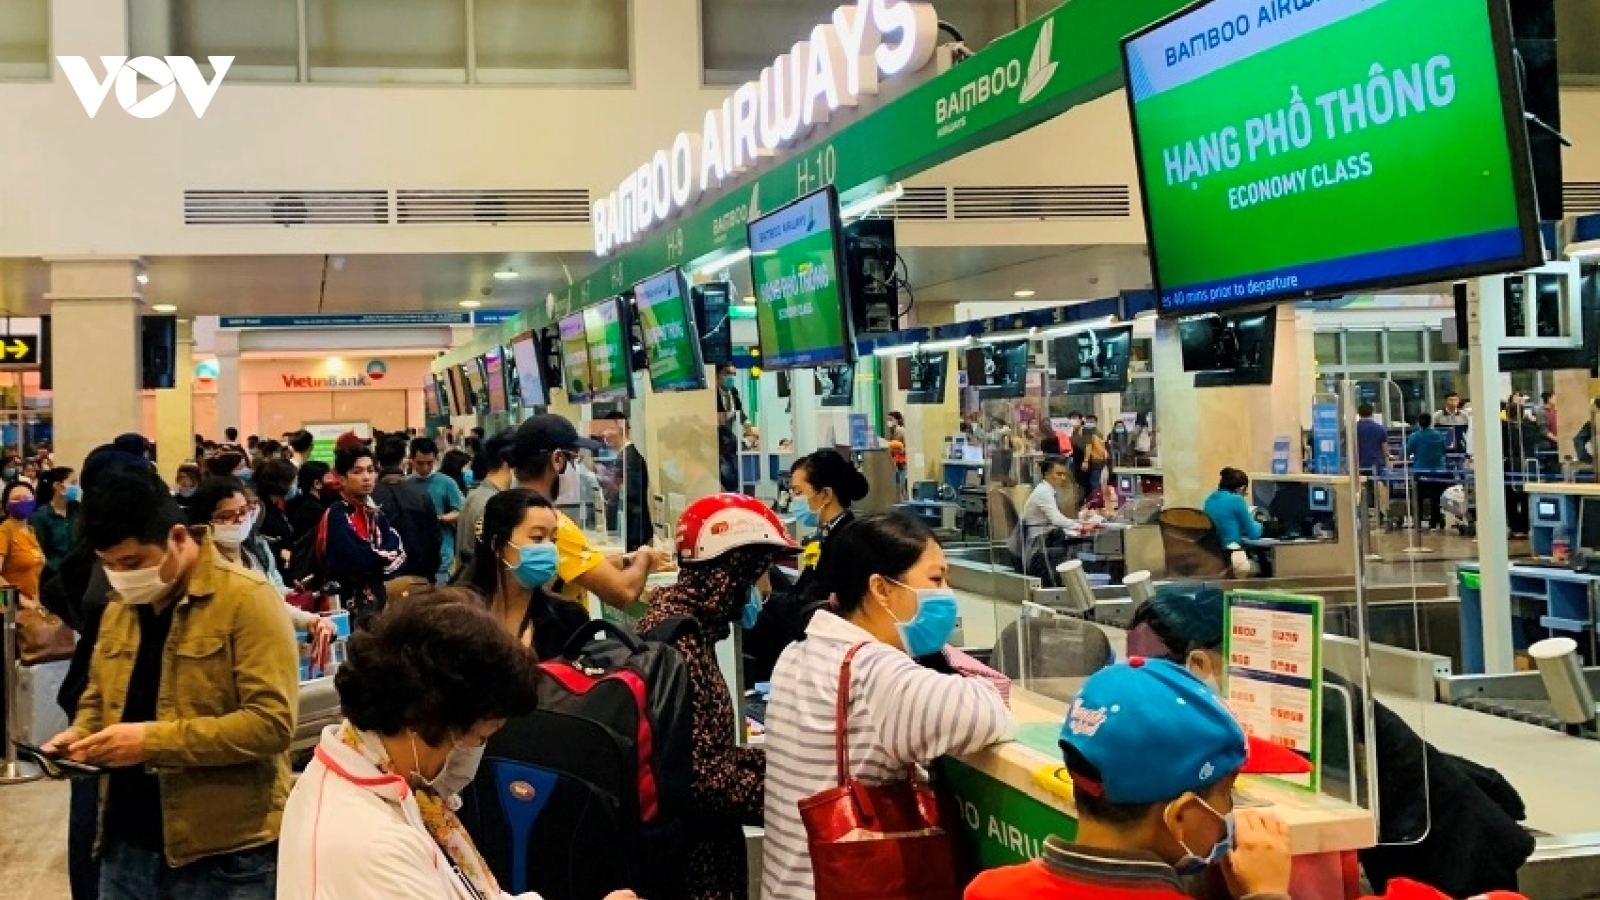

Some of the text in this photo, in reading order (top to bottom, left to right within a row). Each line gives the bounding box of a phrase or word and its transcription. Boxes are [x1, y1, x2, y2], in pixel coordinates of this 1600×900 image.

[1164, 14, 1250, 67] BAMBOO
[935, 58, 1021, 125] BAMBOO
[593, 0, 920, 257] BAMBOO AIRWAYS
[1162, 54, 1456, 191] HẠNG PHỔ THÔNG
[796, 144, 836, 198] H-10
[1228, 151, 1374, 211] ECONOMY CLASS
[1174, 291, 1185, 306] 40
[1209, 283, 1233, 304] prior
[1234, 282, 1245, 296] to
[1247, 273, 1299, 296] departure
[281, 373, 367, 388] VietinBank
